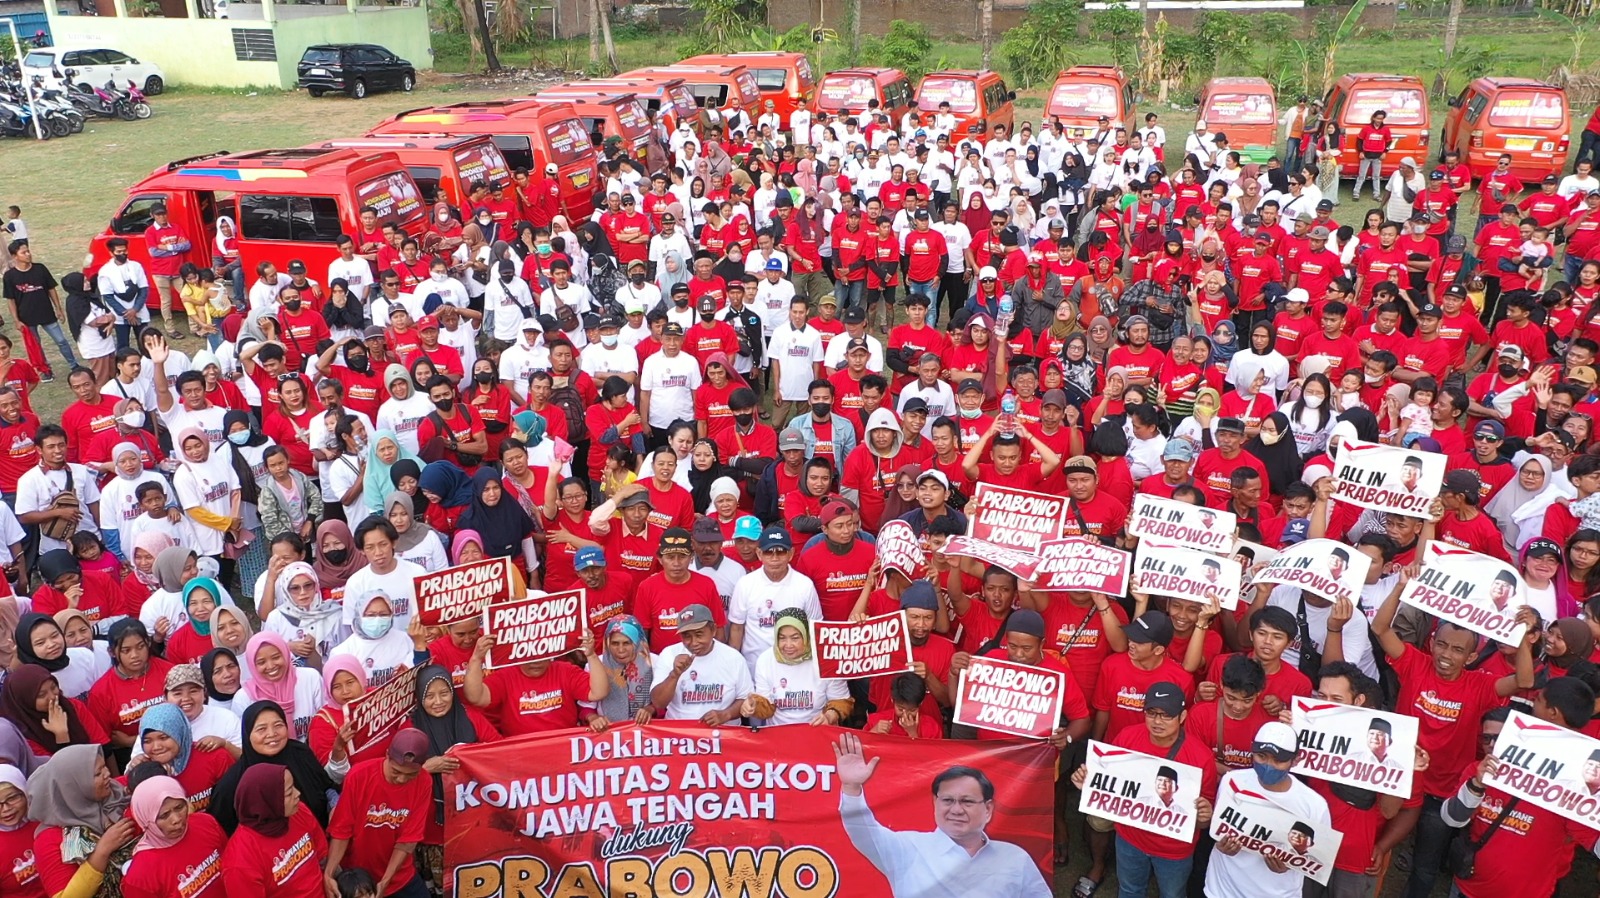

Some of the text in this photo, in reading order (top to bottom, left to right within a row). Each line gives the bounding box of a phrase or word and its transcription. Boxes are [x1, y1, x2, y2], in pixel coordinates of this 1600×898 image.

[1338, 465, 1387, 487] ALL IN
[980, 490, 1060, 517] PRABOWO
[1336, 481, 1430, 513] PRABOWO!!
[979, 508, 1056, 533] LANJUTKAN
[1139, 504, 1185, 523] ALL IN
[987, 528, 1042, 548] JOKOWI
[1135, 518, 1226, 549] PRABOWO!!
[1036, 557, 1119, 576] LANJUTKAN
[1042, 542, 1122, 564] PRABOWO
[1141, 556, 1187, 577] ALL IN
[1268, 556, 1313, 570] ALL IN
[419, 562, 503, 597] PRABOWO
[1048, 572, 1105, 587] JOKOWI
[1417, 568, 1475, 600] ALL IN
[424, 578, 503, 612] LANJUTKAN
[493, 596, 578, 629] PRABOWO
[1410, 585, 1518, 638] PRABOWO!!
[496, 616, 576, 645] LANJUTKAN
[819, 618, 899, 644] PRABOWO
[508, 636, 566, 660] JOKOWI
[823, 637, 900, 660] LANJUTKAN
[836, 654, 890, 675] JOKOWI
[968, 664, 1056, 695] PRABOWO
[968, 685, 1052, 714] LANJUTKAN
[367, 695, 414, 737] JOKOWI
[976, 706, 1037, 732] JOKOWI
[569, 730, 722, 764] Deklarasi
[1299, 729, 1326, 751] ALL
[1331, 735, 1351, 756] IN
[1299, 749, 1404, 790] PRABOWO!!
[1499, 744, 1565, 780] ALL IN
[455, 762, 836, 811] KOMUNITAS ANGKOT
[1089, 772, 1141, 799] ALL IN
[519, 793, 774, 838] JAWA TENGAH
[1086, 790, 1188, 834] PRABOWO!!
[1220, 806, 1273, 841] ALL IN
[600, 820, 693, 858] dukung
[274, 841, 312, 882] PRABOWO
[454, 846, 840, 898] PRABOWO
